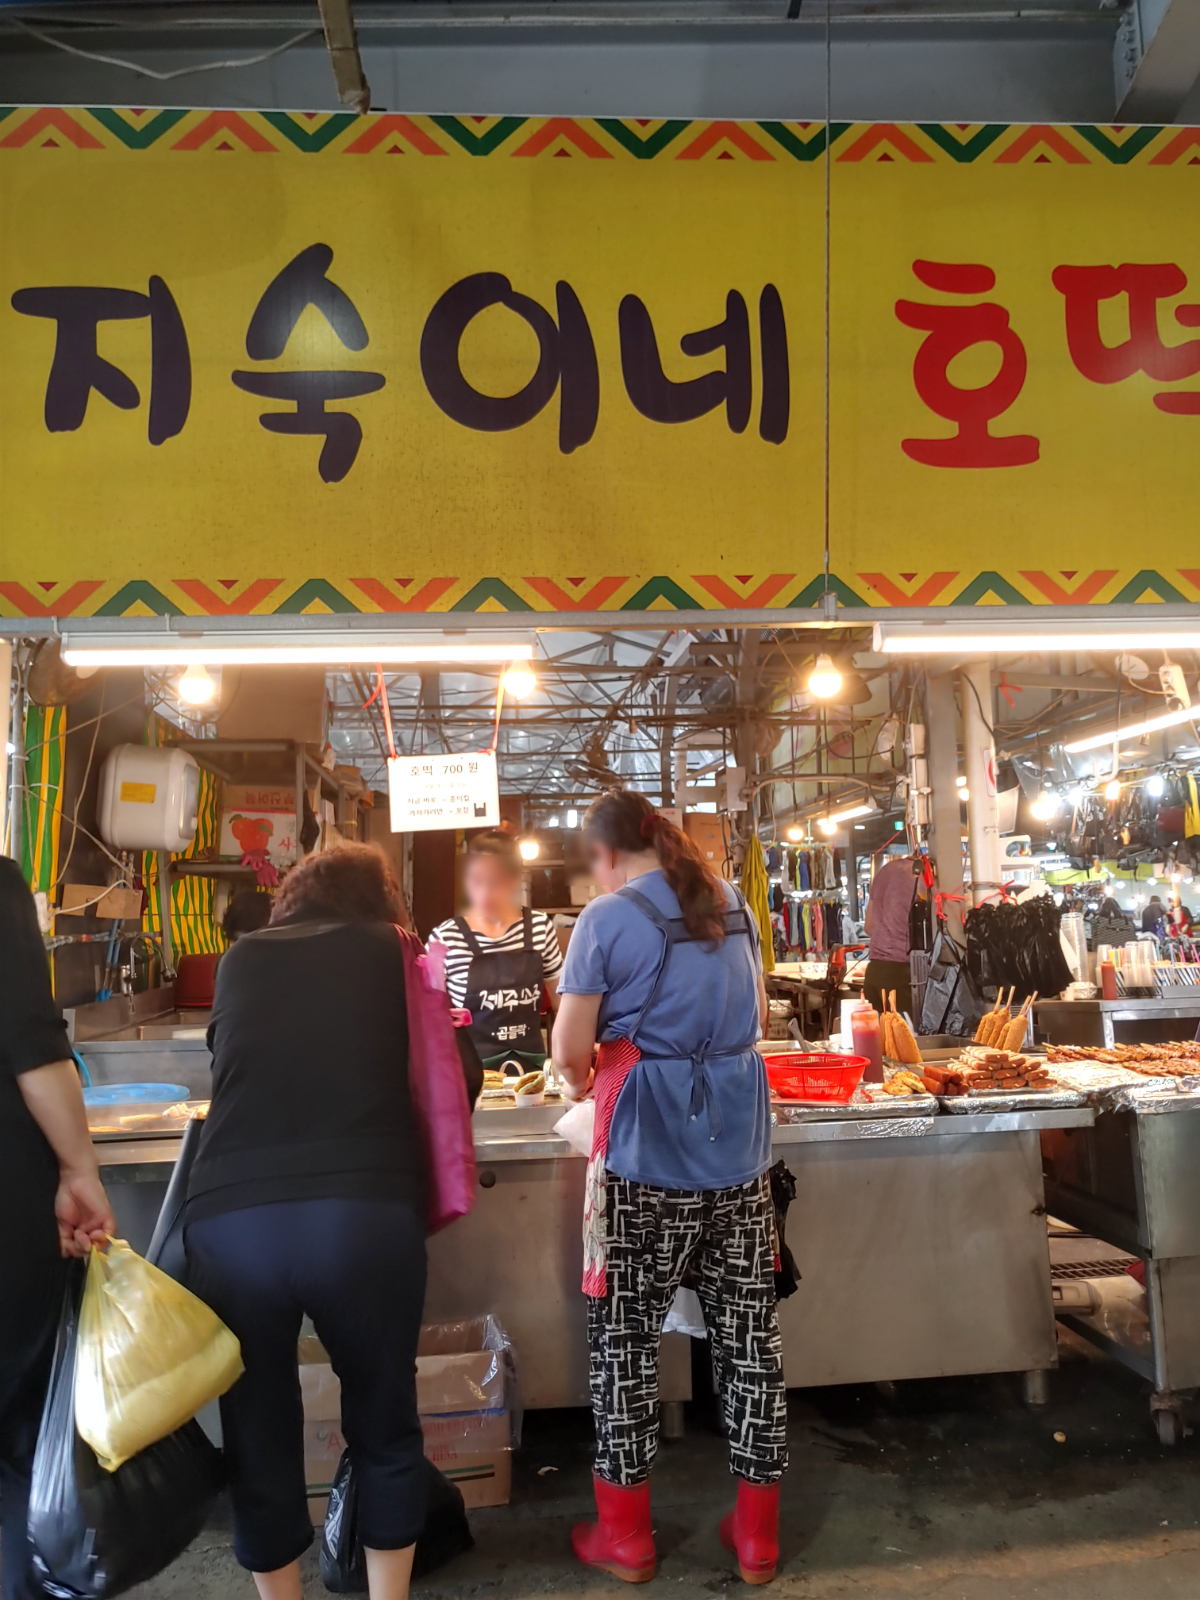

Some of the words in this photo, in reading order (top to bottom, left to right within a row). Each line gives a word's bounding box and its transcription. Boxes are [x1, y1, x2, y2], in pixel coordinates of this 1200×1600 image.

[11, 242, 790, 484] 지숙이네
[411, 765, 433, 776] 호떡
[442, 764, 463, 774] 700
[468, 762, 478, 774] 원
